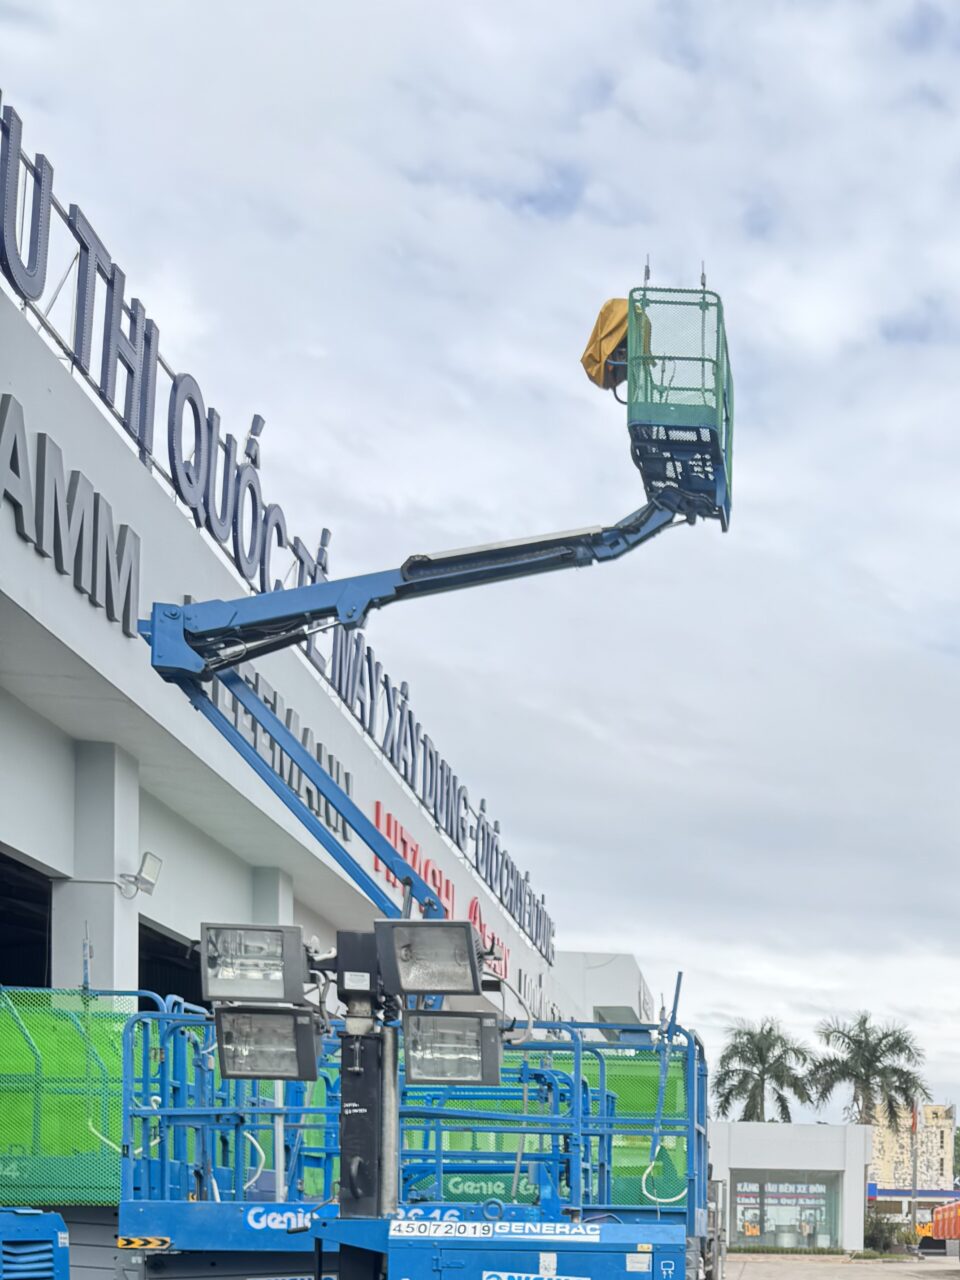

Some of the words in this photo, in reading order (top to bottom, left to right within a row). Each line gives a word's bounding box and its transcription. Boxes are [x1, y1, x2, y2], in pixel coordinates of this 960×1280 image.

[450, 1177, 505, 1195] Genie
[392, 1223, 491, 1237] 45072019
[495, 1222, 601, 1235] GENERAC
